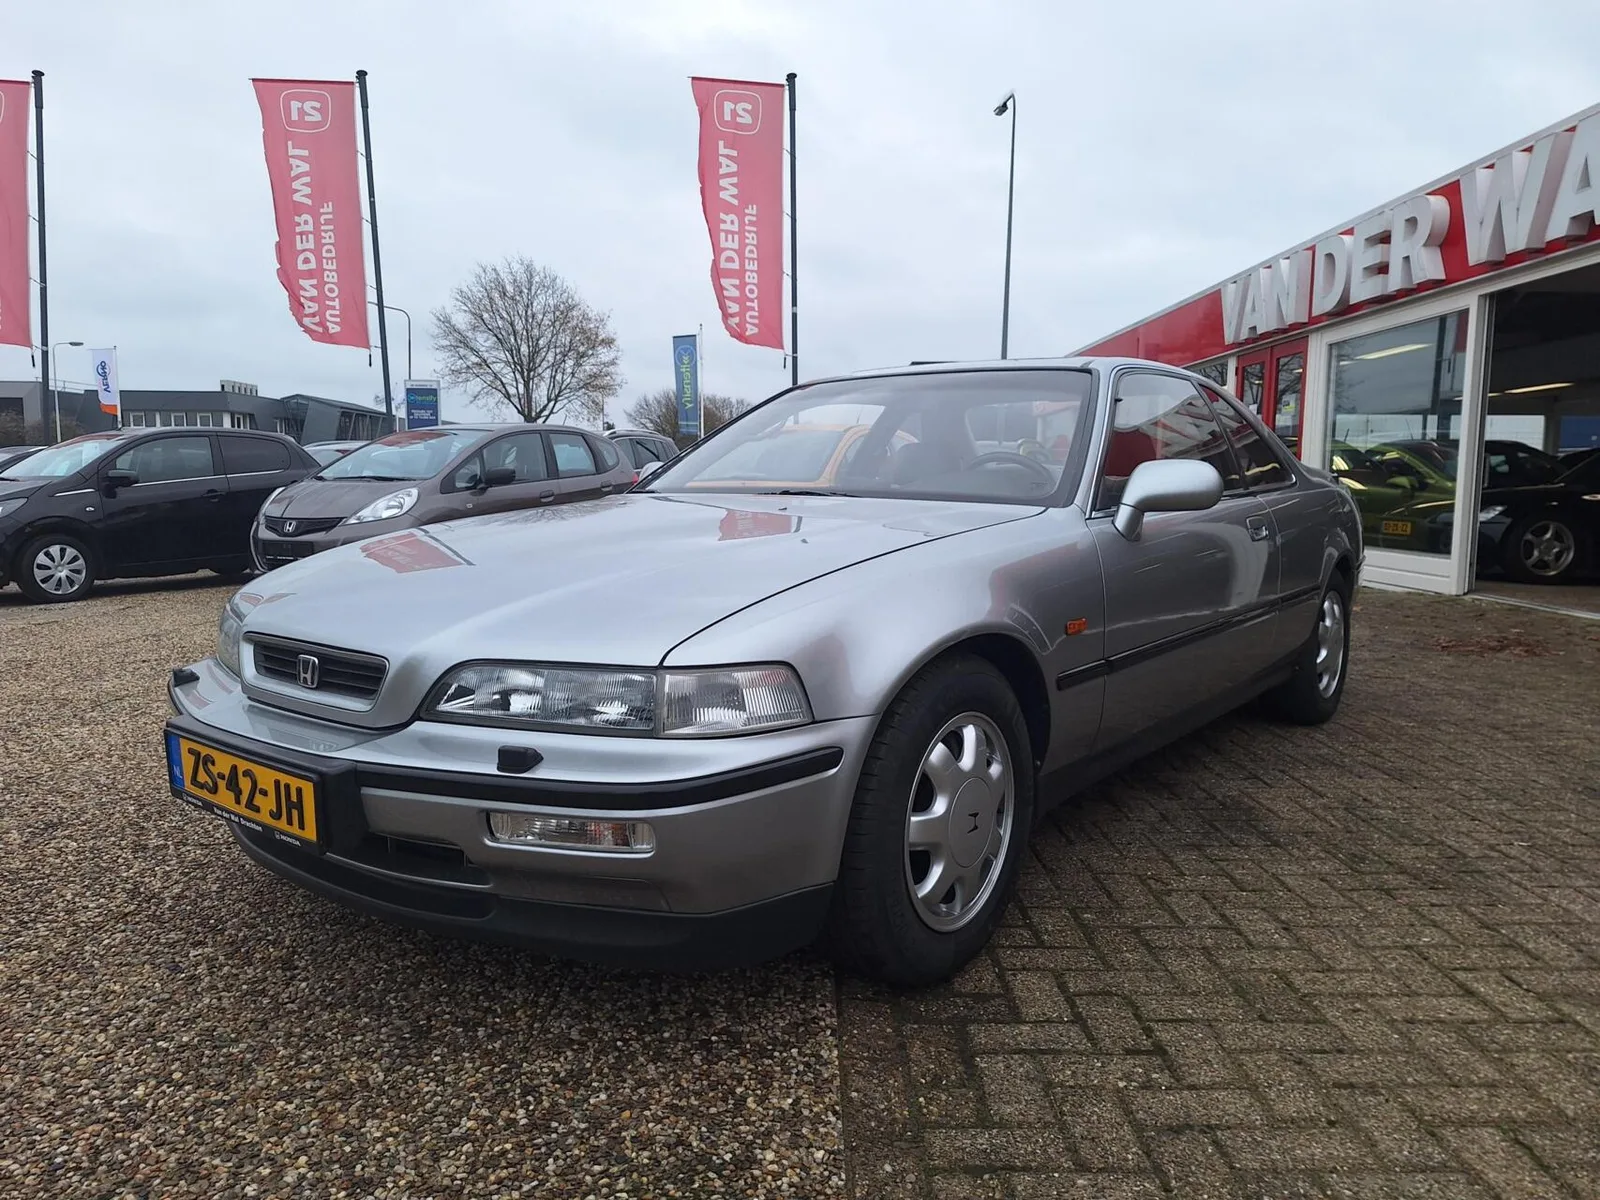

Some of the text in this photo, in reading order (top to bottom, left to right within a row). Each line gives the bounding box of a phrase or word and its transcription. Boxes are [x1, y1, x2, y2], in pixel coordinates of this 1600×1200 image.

[1221, 248, 1313, 345] VAN
[1312, 194, 1451, 317] DER
[173, 764, 183, 779] NL
[187, 747, 306, 832] ZS-42-JH
